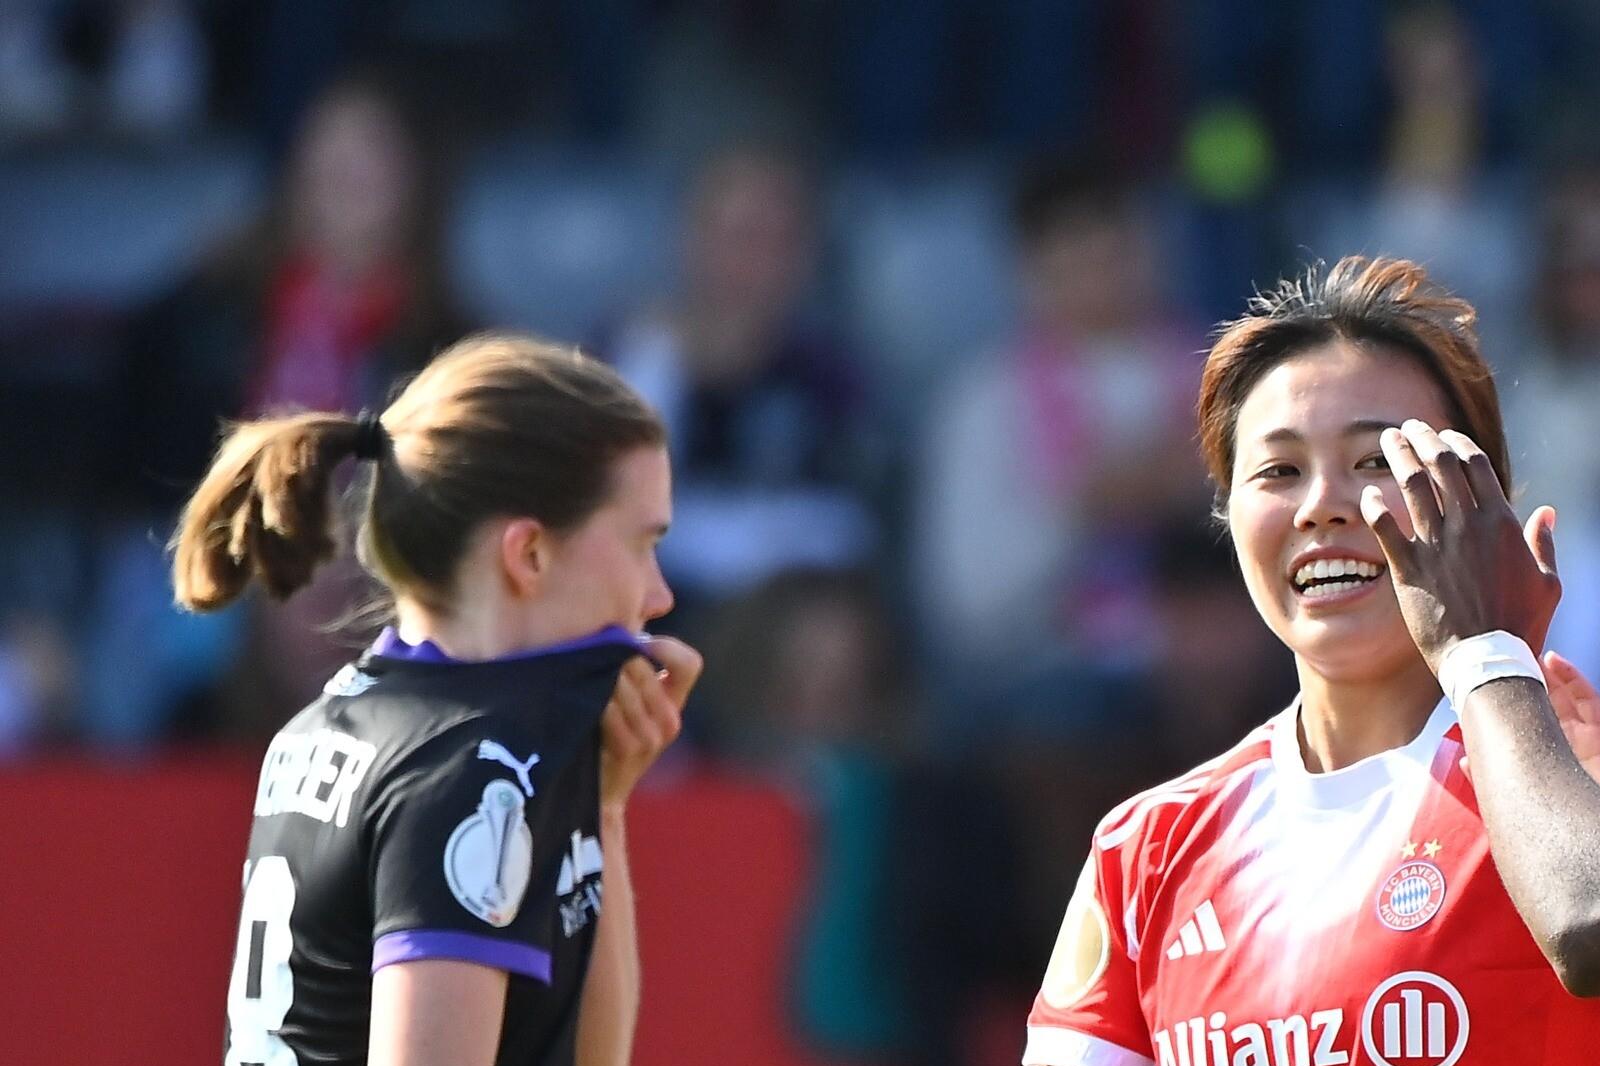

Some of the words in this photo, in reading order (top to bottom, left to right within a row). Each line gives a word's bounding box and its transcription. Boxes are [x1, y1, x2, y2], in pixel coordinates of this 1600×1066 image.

[254, 728, 377, 828] EBER
[1383, 876, 1400, 893] FC
[1401, 865, 1441, 891] BAYERN
